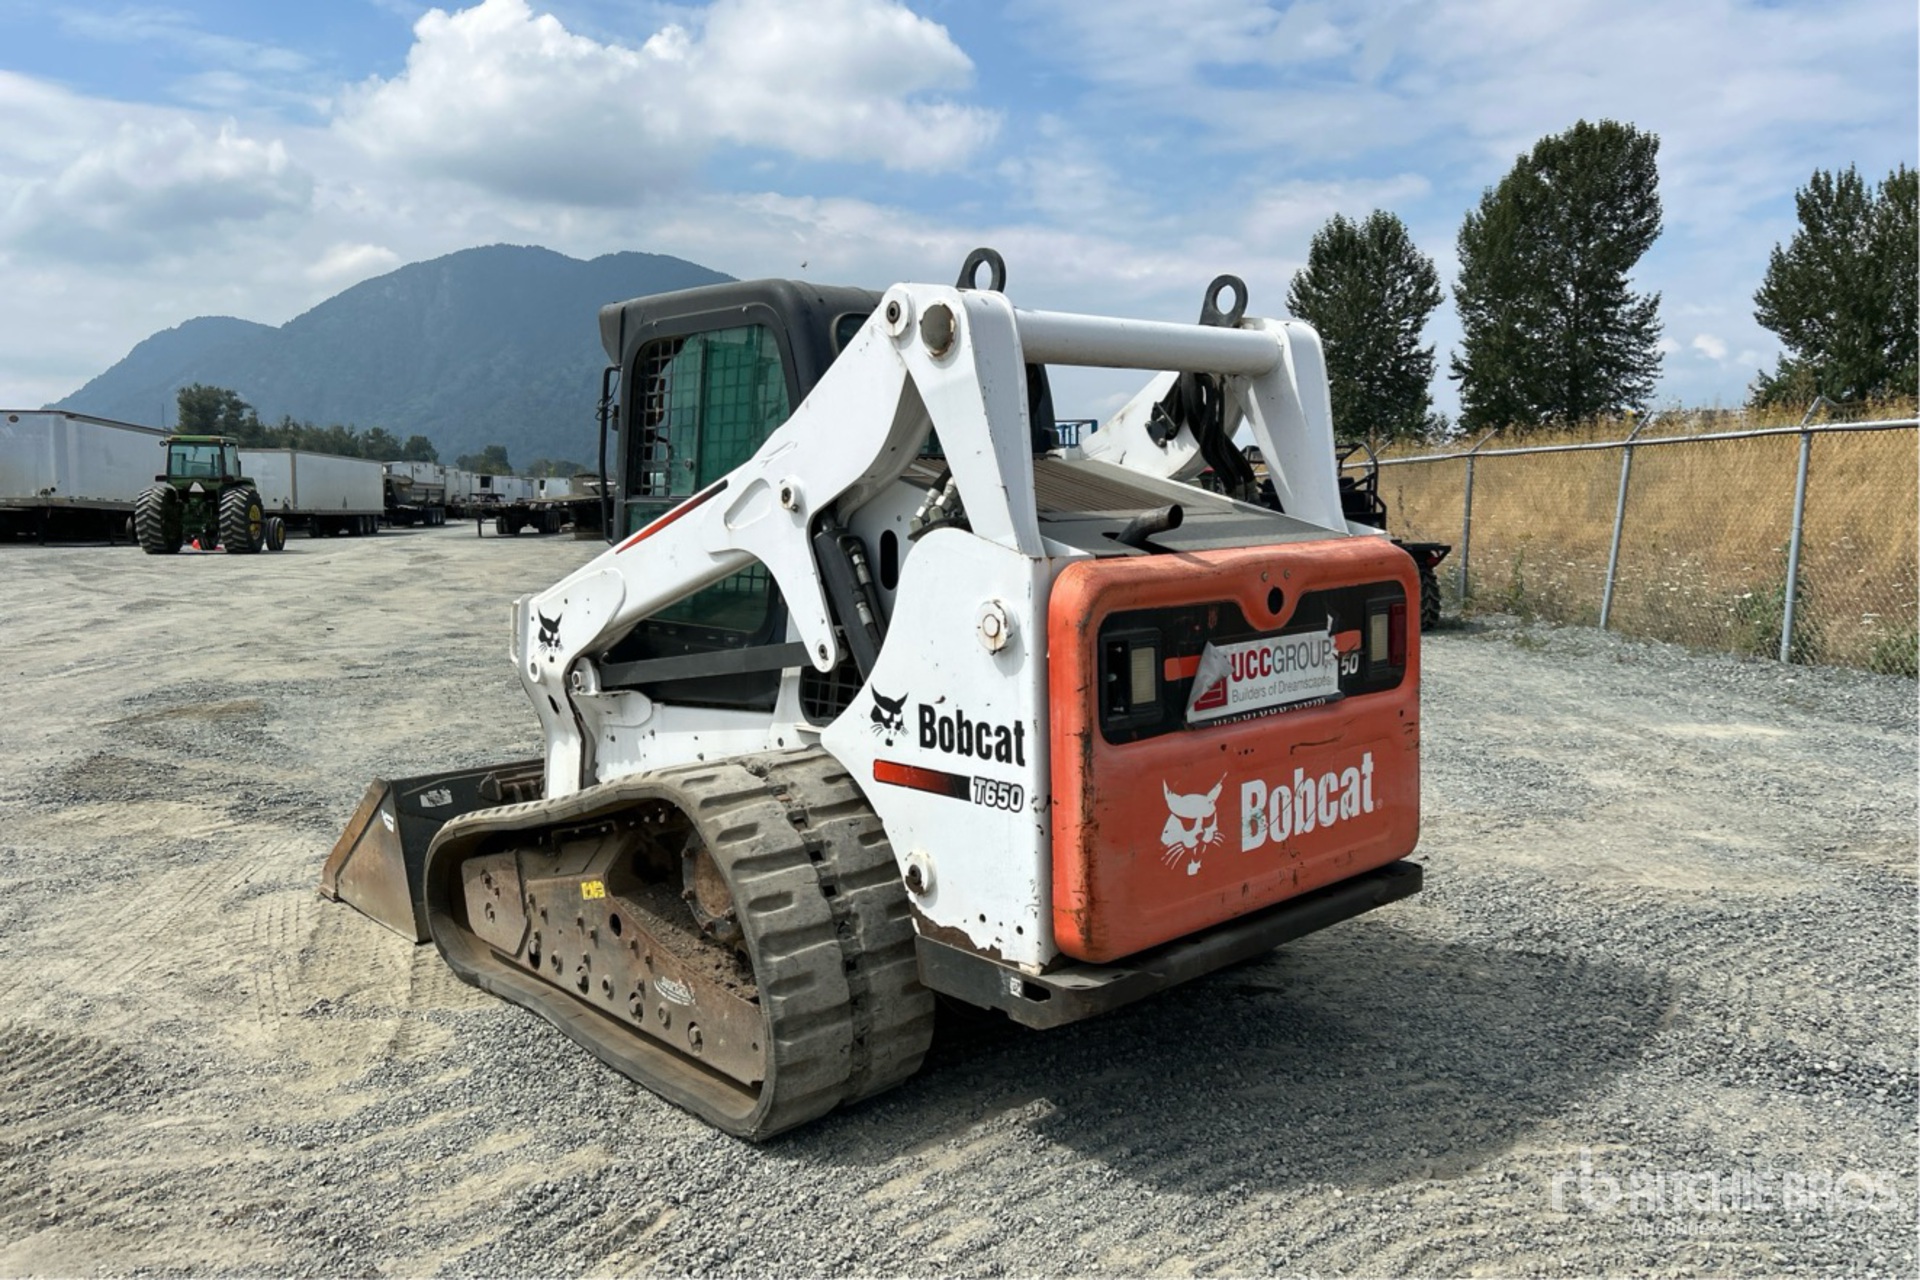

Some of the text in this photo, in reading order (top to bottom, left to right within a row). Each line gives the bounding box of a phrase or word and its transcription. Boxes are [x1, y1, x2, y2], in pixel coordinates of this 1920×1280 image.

[1232, 686, 1266, 703] Builders
[1268, 684, 1277, 696] of
[918, 703, 1026, 767] Bobcat
[973, 775, 1025, 813] T650
[1241, 751, 1374, 853] Bobcat
